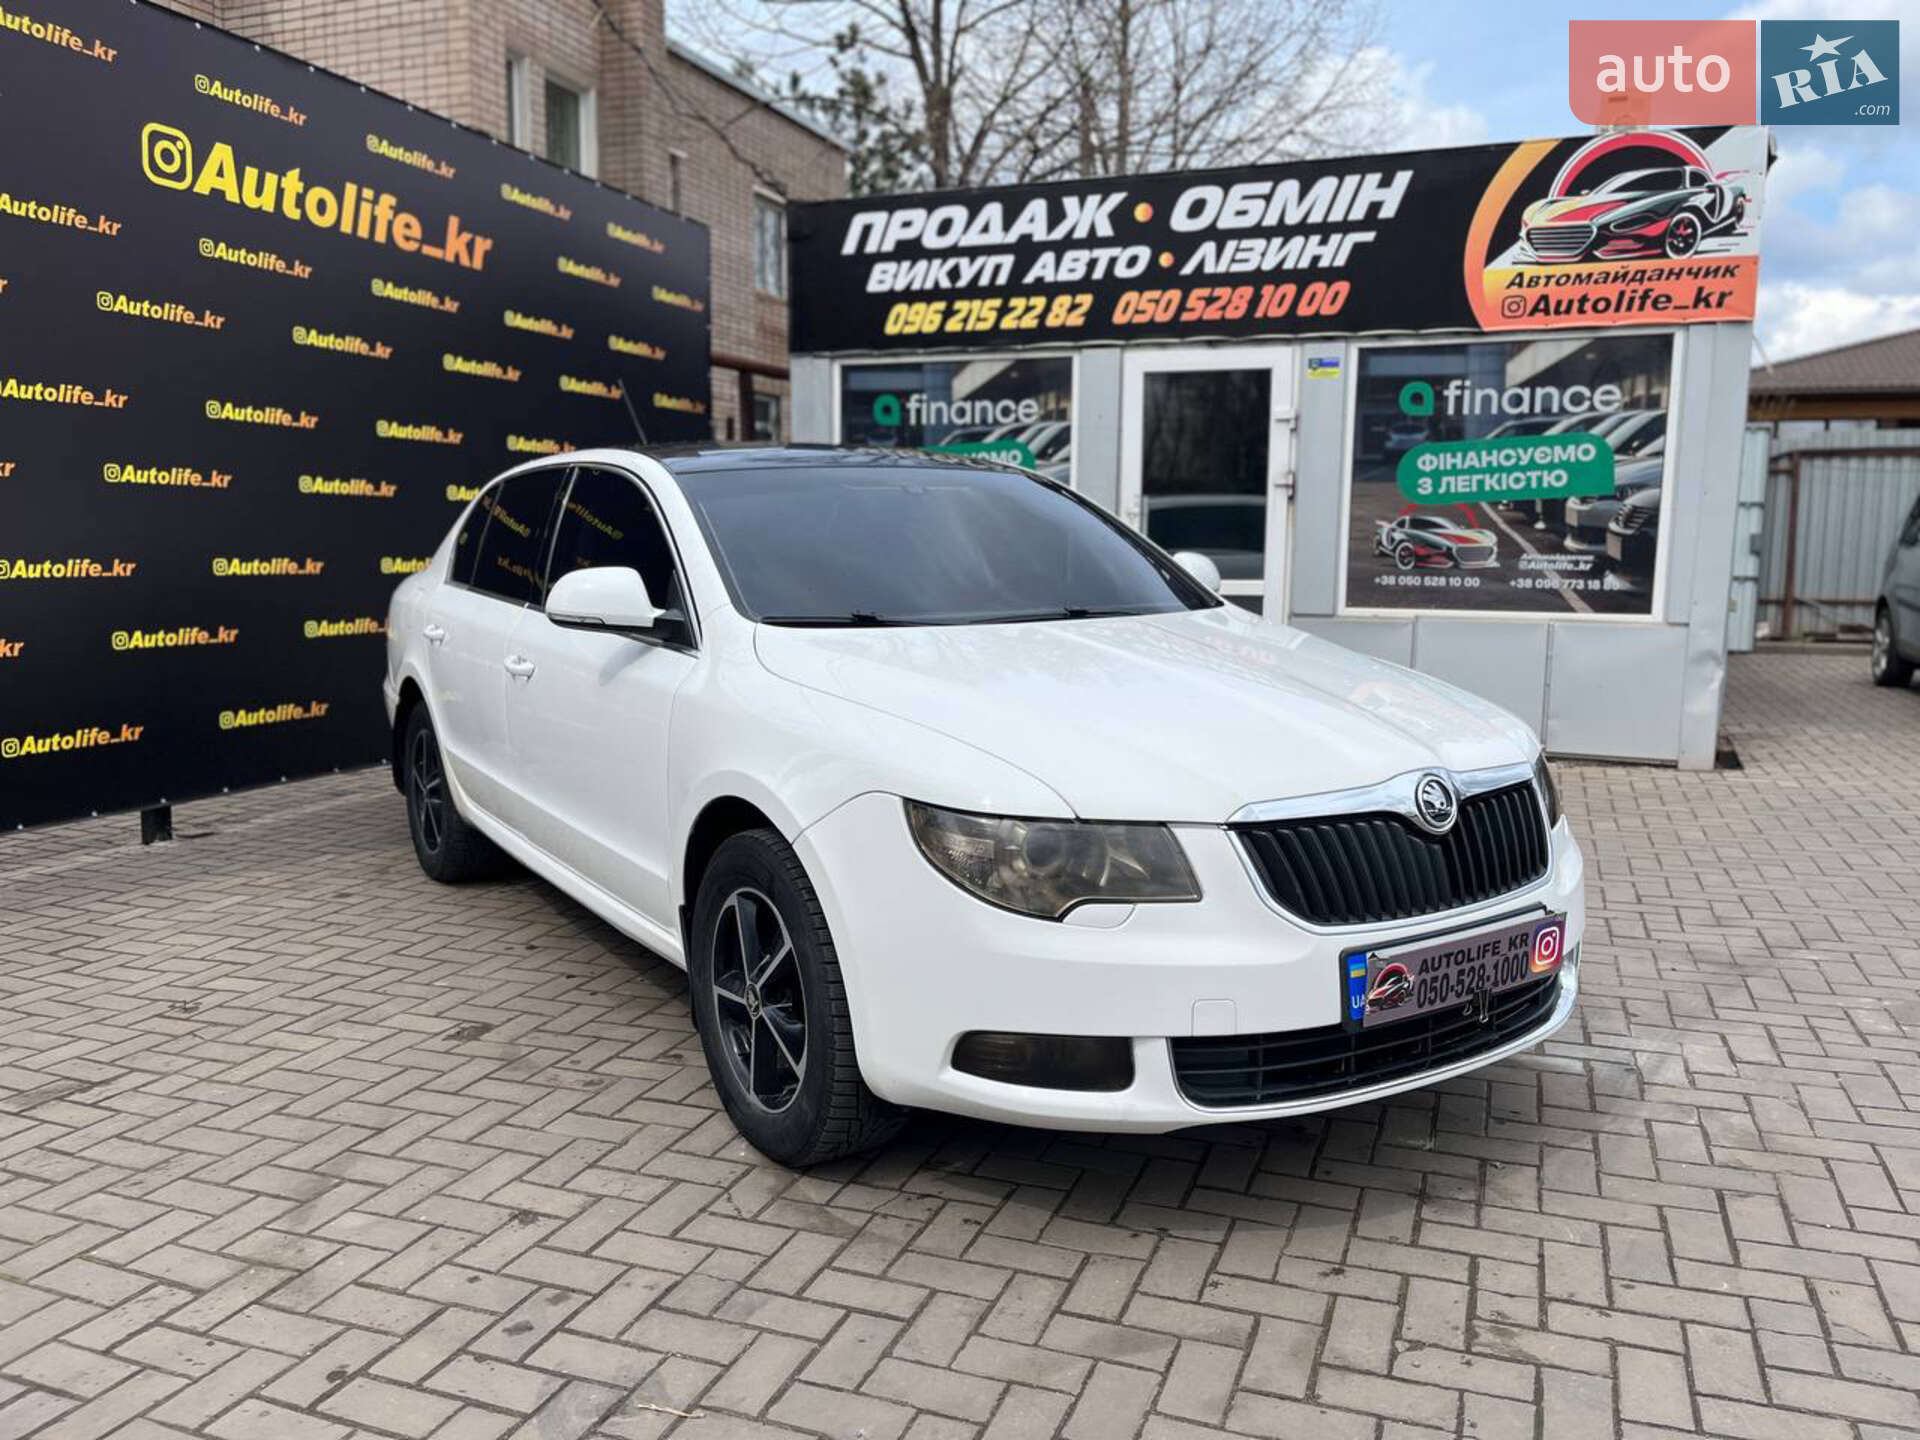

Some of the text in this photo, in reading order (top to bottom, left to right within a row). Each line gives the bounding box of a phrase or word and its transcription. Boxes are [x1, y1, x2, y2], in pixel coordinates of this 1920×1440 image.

[193, 142, 493, 271] Autolife_kr
[841, 170, 1414, 255] ПРОДАЖ ОБМІН
[866, 236, 1377, 293] ВИКУП АВТО ЛІЗИНГ
[1506, 262, 1741, 290] Автомайданчик
[884, 280, 1351, 335] 096 215 22 82 050 528 10 00
[1528, 286, 1733, 317] Autolife_kr
[906, 393, 1038, 426] finance
[1443, 380, 1622, 416] finance
[1416, 443, 1596, 472] ФІНАНСУЄМО
[1417, 469, 1568, 495] З ЛЕГКІСТЮ
[1374, 575, 1396, 586] +38
[1449, 577, 1461, 587] 10
[1463, 577, 1480, 587] 00
[1418, 933, 1529, 976] AUTOLIFE_KR
